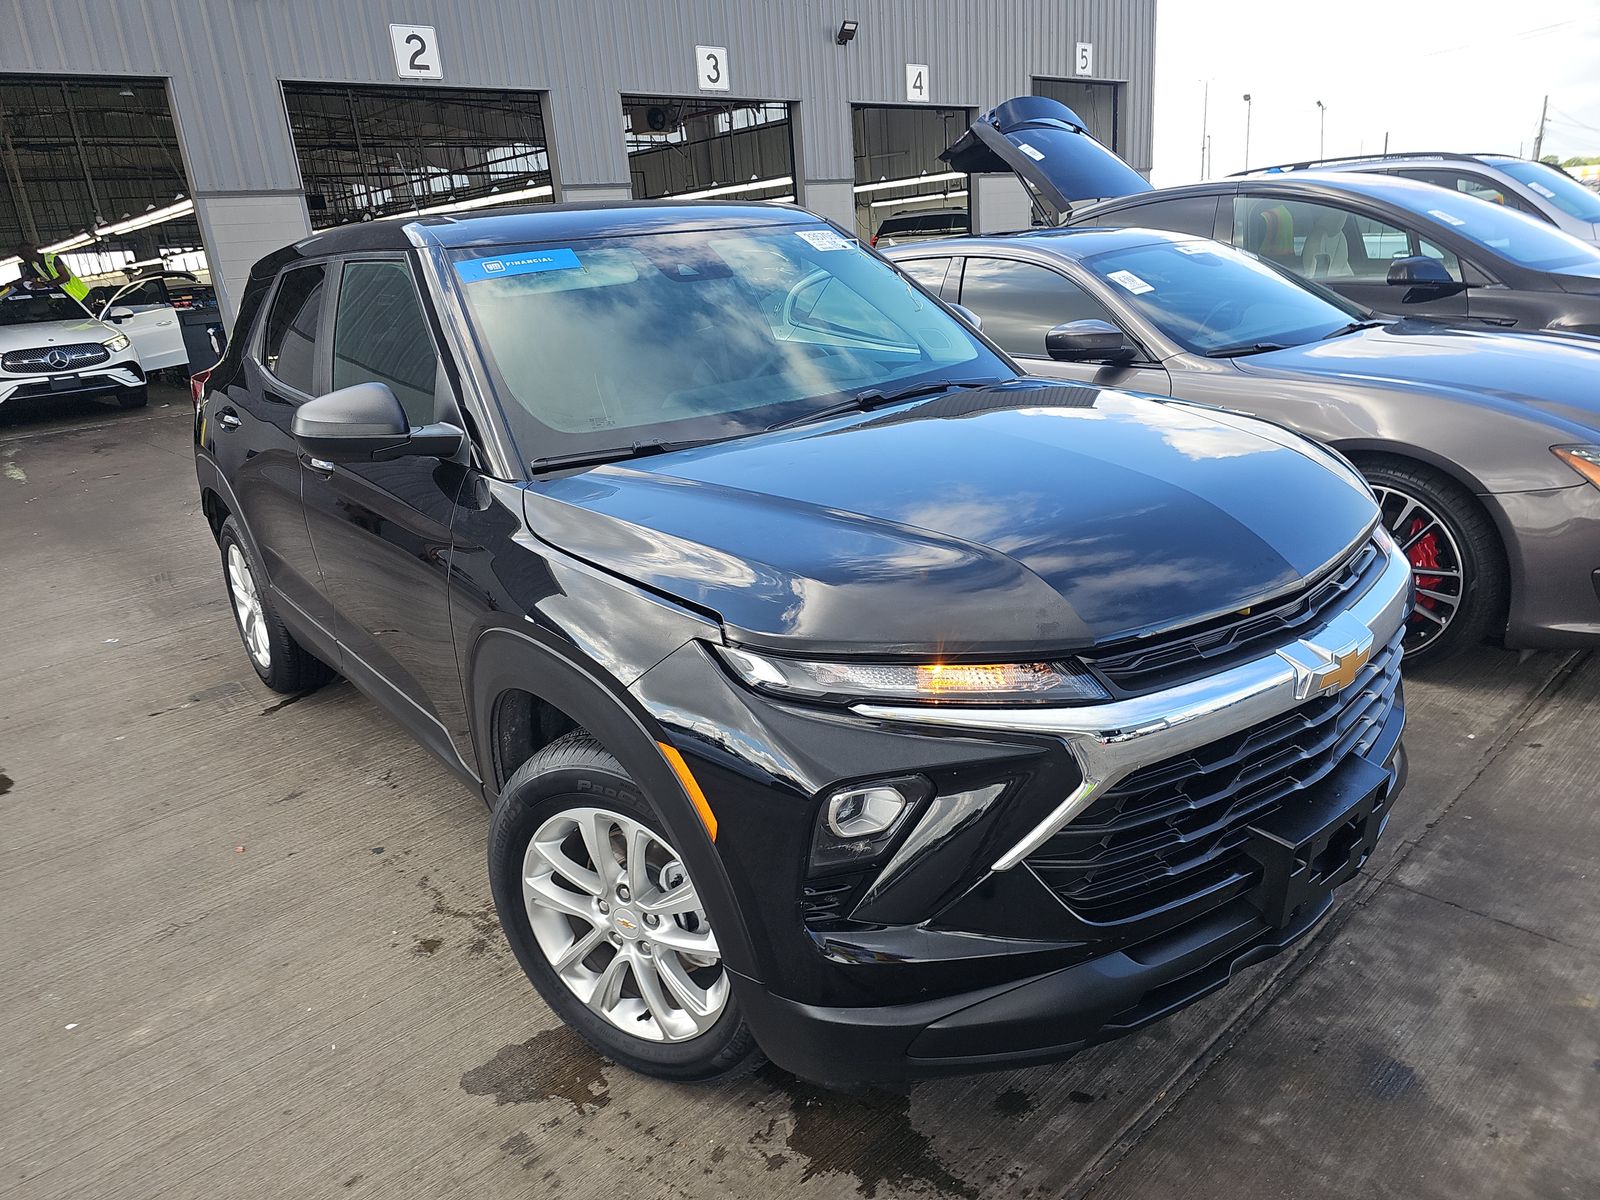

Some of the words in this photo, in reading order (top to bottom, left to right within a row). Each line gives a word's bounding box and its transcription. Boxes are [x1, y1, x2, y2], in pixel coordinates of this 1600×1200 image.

[405, 34, 431, 71] 2
[1080, 48, 1088, 70] 5
[706, 53, 720, 84] 3
[912, 71, 924, 96] 4
[505, 257, 553, 267] FINANCIAL
